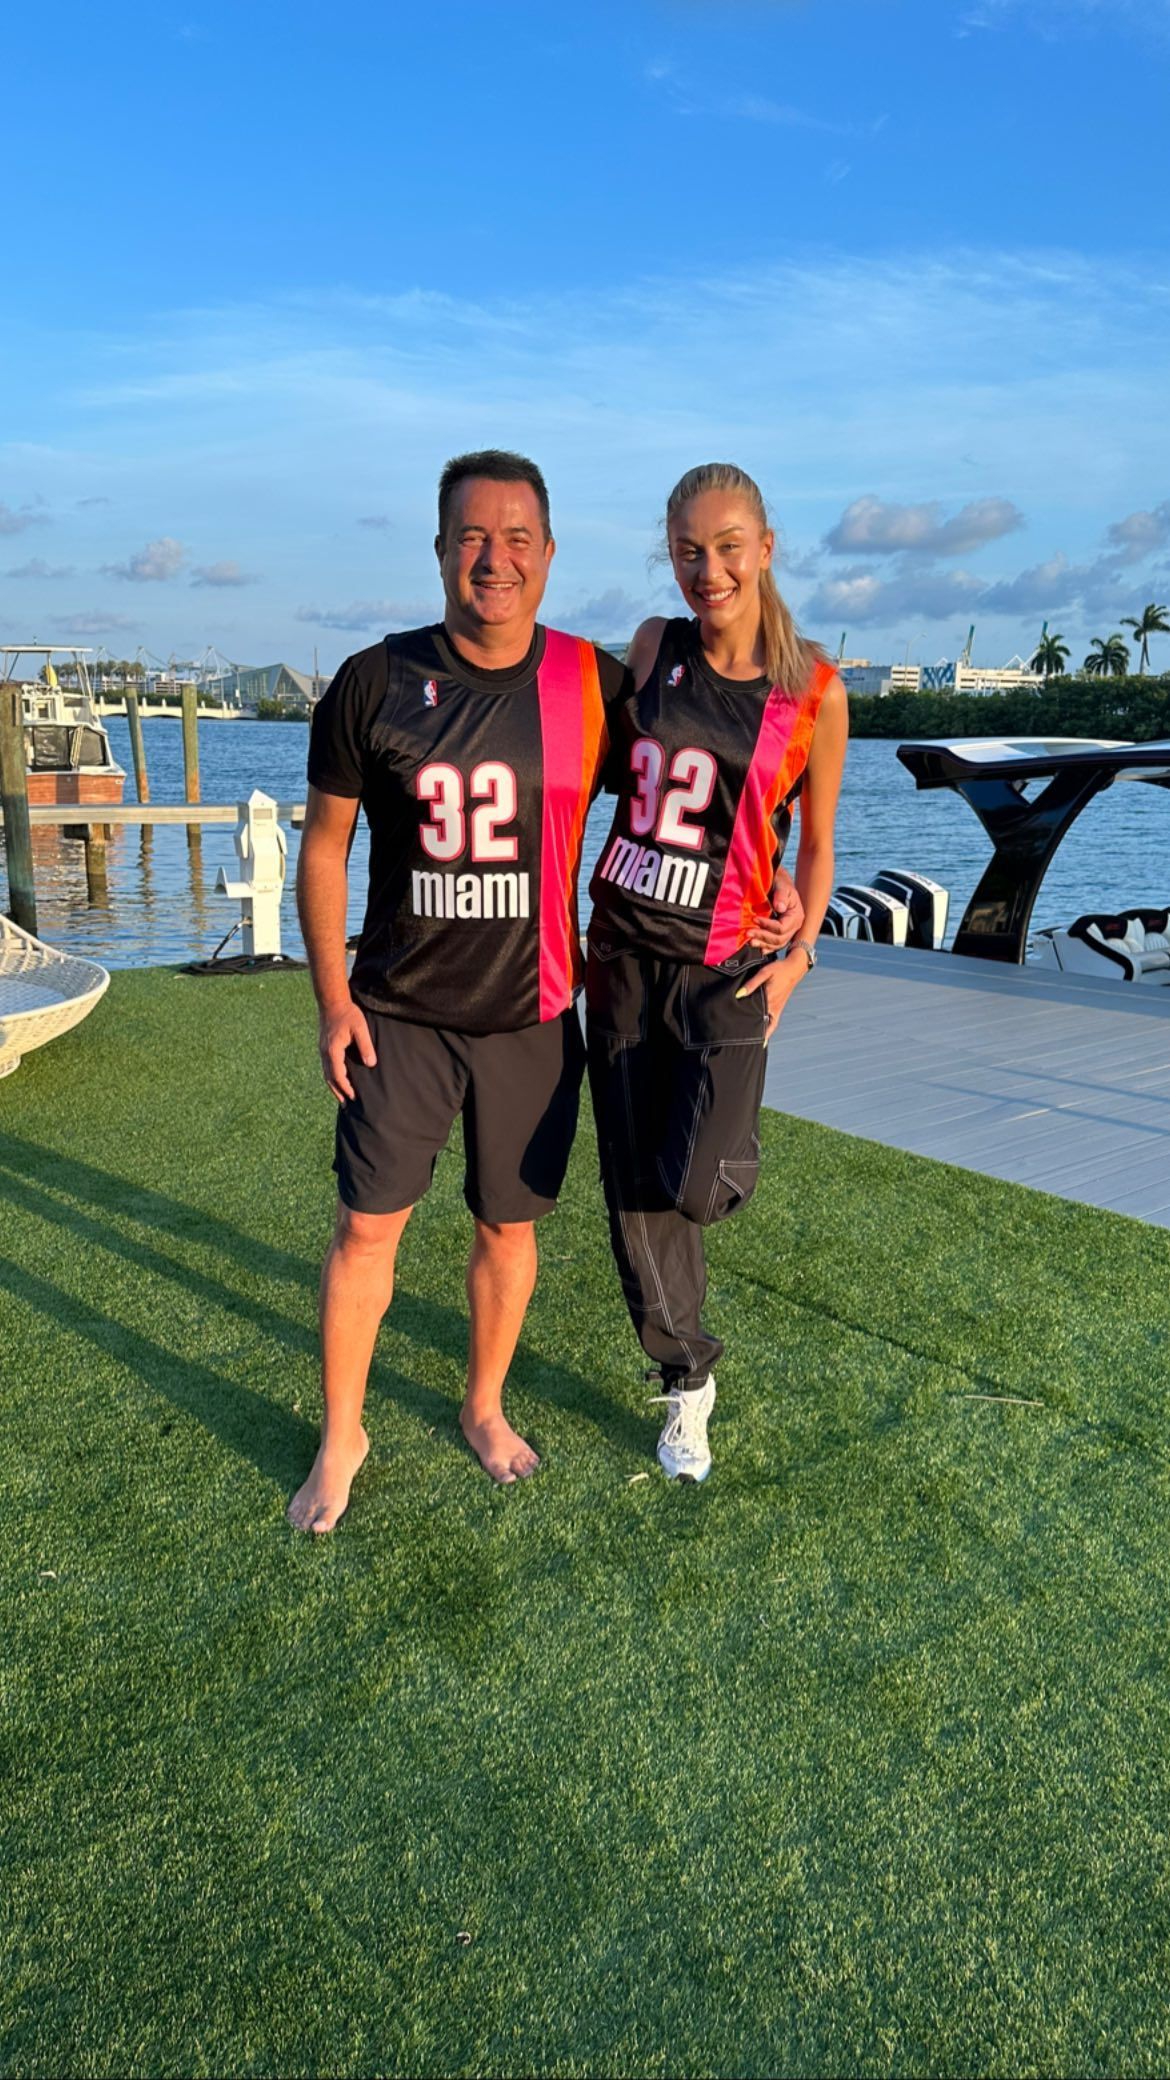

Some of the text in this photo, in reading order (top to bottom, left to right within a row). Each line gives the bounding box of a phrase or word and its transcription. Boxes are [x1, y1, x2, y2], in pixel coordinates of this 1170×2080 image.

[416, 760, 518, 862] 32
[630, 737, 717, 850] 32
[412, 870, 530, 919] miami
[600, 836, 709, 909] miami
